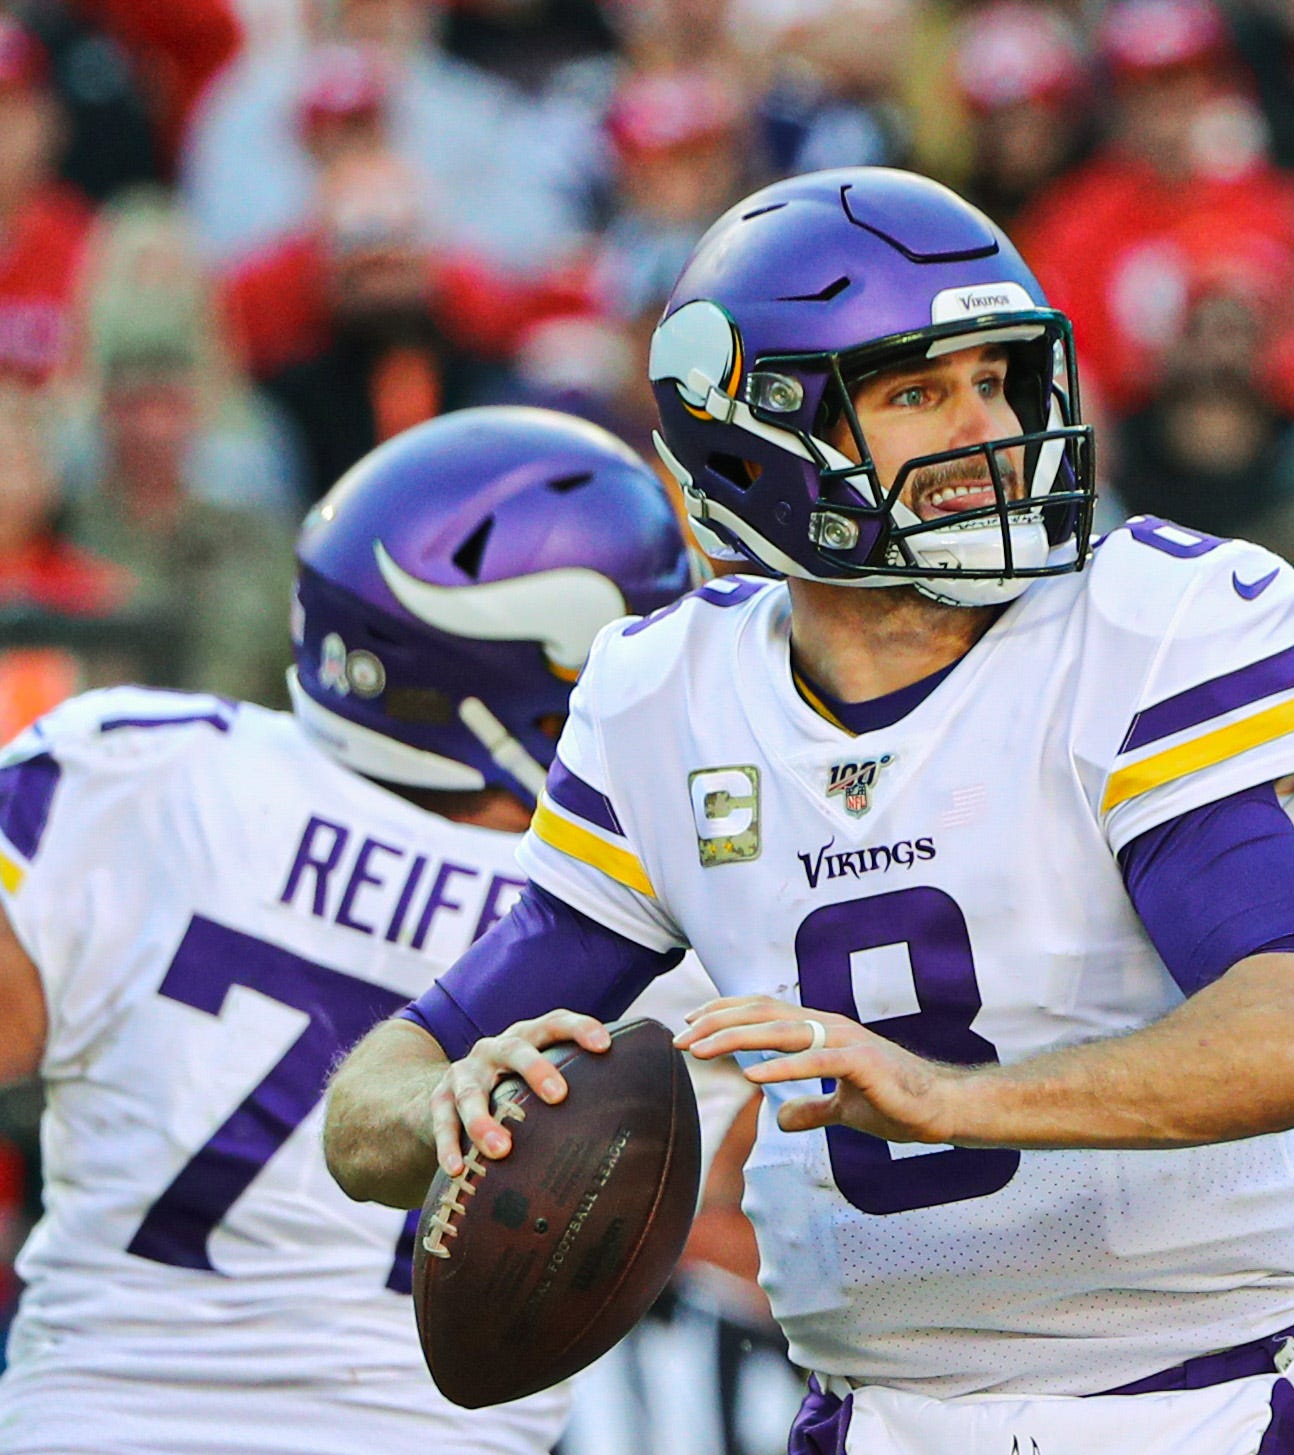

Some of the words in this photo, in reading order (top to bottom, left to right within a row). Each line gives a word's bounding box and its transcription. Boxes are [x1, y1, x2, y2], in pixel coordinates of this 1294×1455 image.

[691, 773, 754, 839] C
[847, 794, 867, 811] NFL
[795, 885, 1020, 1215] 8
[125, 913, 418, 1296] 7
[547, 1190, 599, 1273] FOOTBALL
